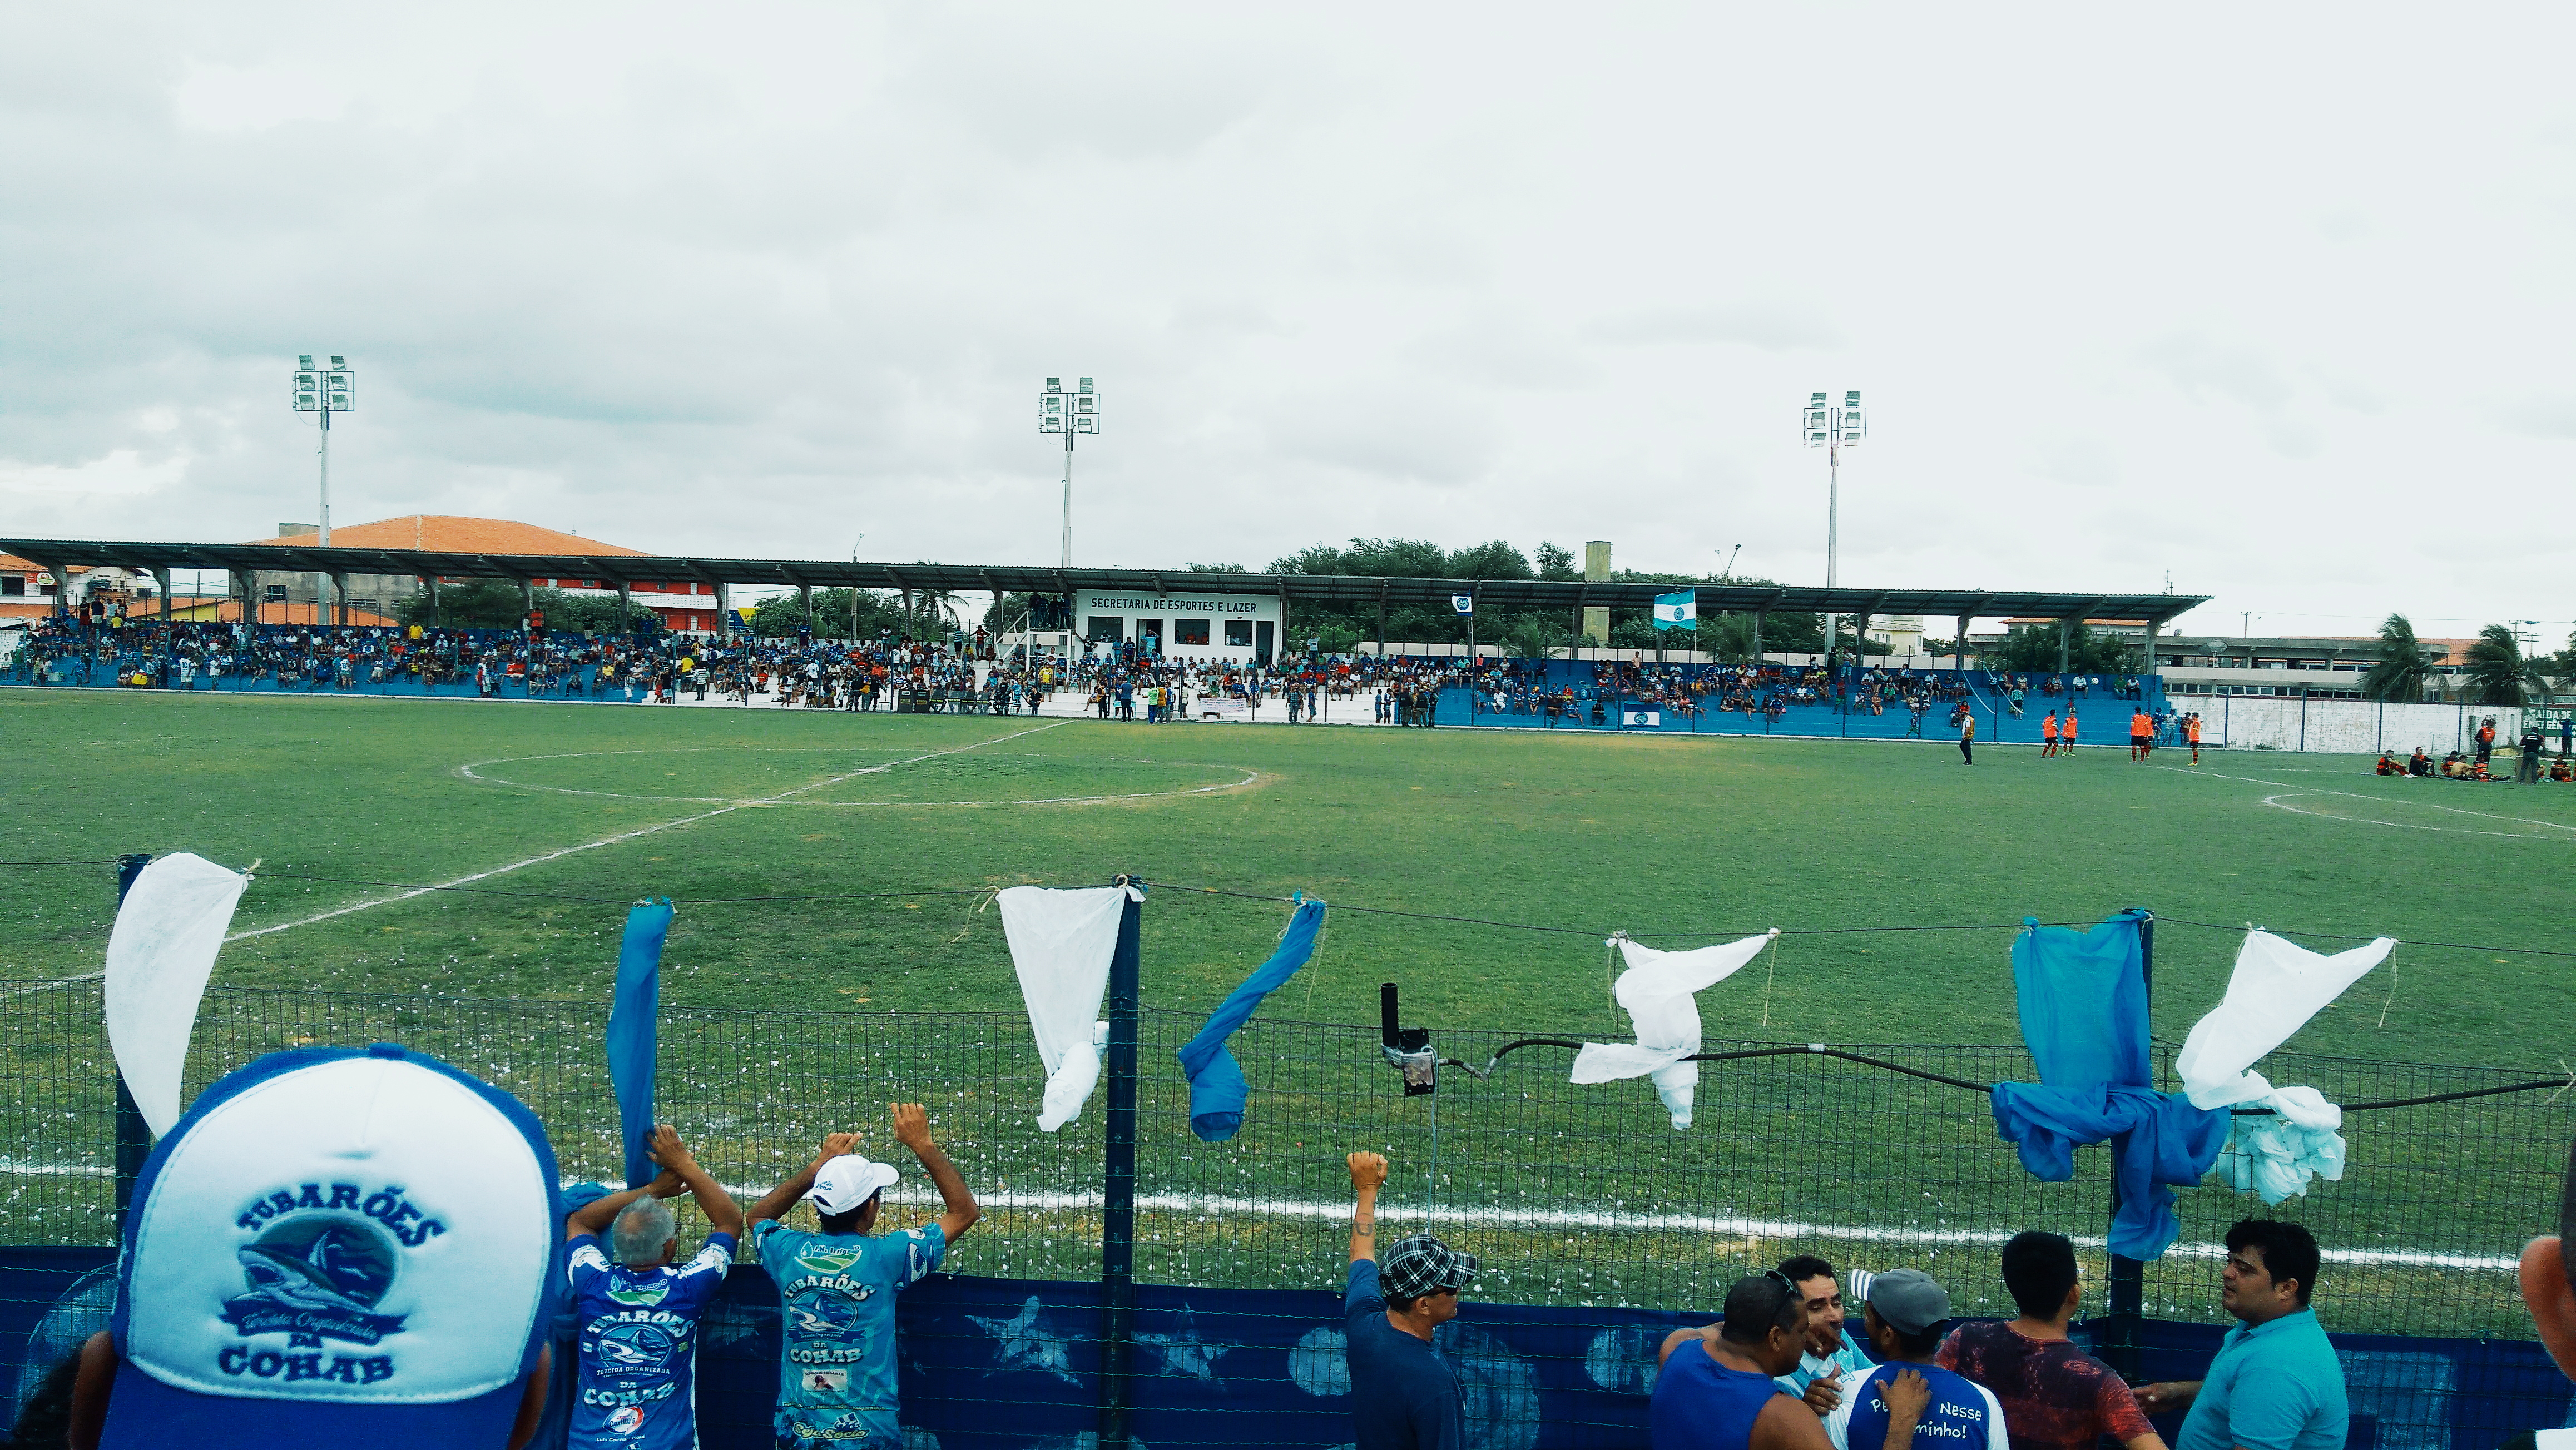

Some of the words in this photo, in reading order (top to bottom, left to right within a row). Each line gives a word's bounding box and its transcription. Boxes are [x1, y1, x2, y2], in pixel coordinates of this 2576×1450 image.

[1091, 598, 1150, 609] SECRETARIA
[1153, 599, 1165, 610] DE
[1168, 600, 1215, 612] ESPORTES
[1218, 602, 1223, 612] E
[1227, 602, 1257, 613] LAZER
[2561, 711, 2572, 719] DE
[236, 1183, 447, 1248] TUBARÕES
[784, 1273, 876, 1300] TUBARÕES
[790, 1348, 862, 1364] COHAB
[219, 1347, 394, 1384] COHAB
[1939, 1402, 1982, 1421] Nesse
[1914, 1421, 1967, 1439] minho!
